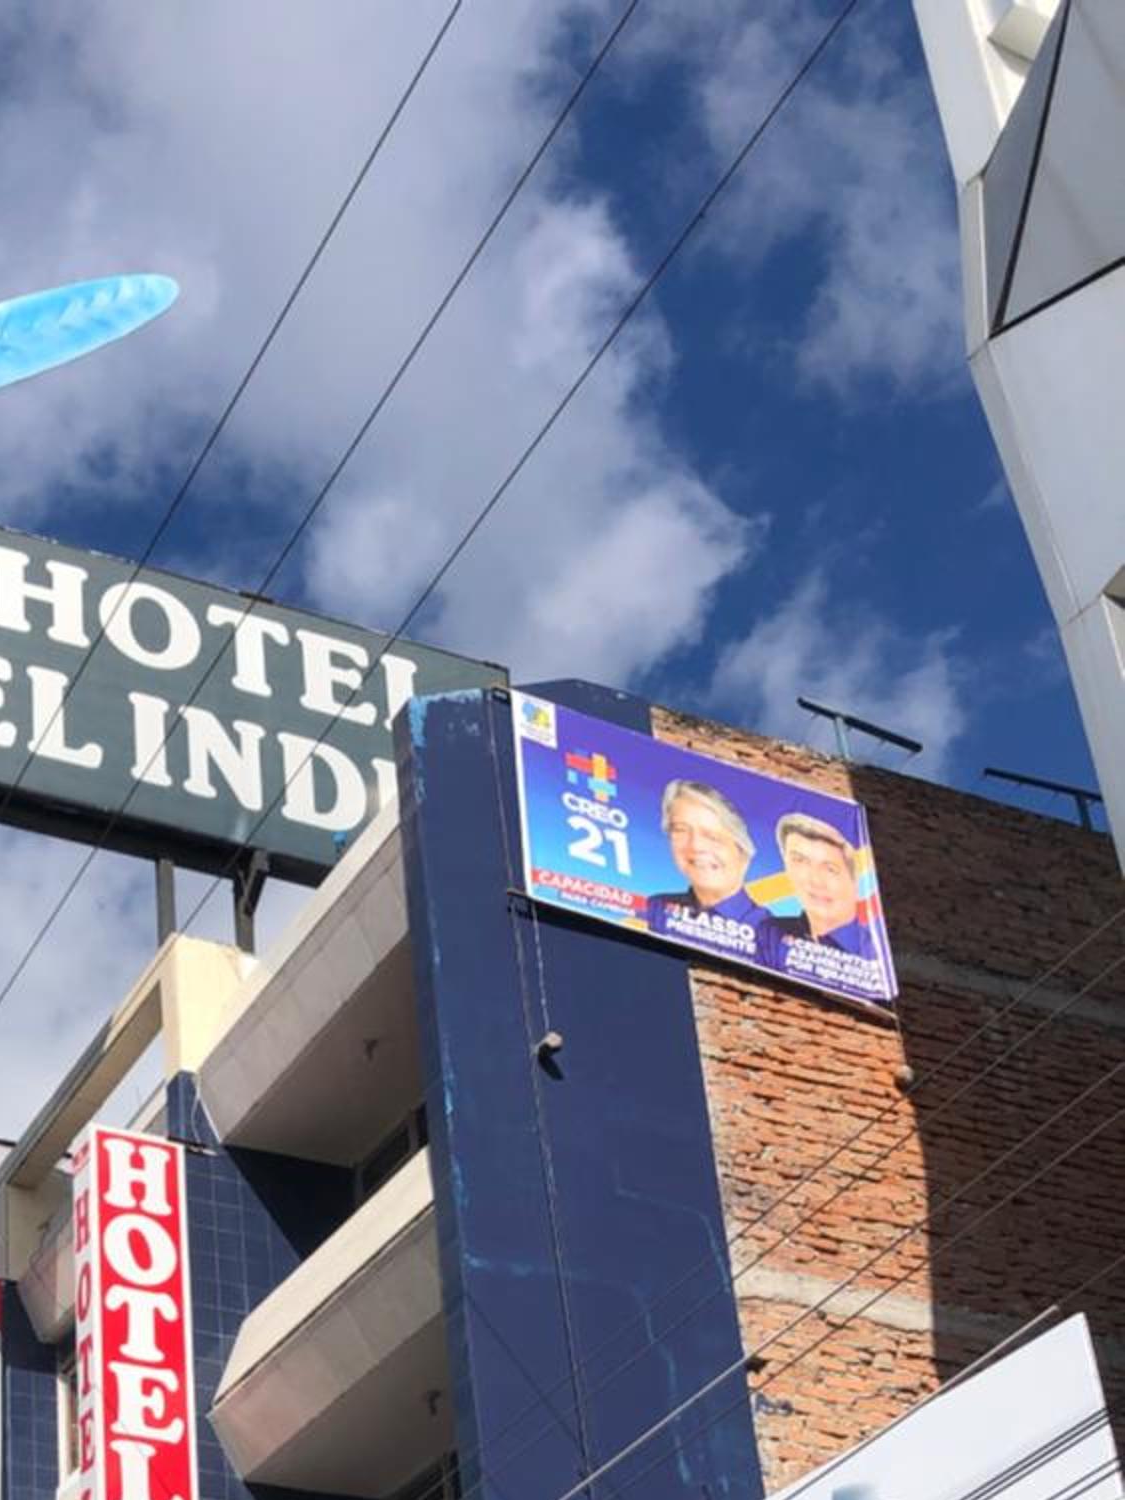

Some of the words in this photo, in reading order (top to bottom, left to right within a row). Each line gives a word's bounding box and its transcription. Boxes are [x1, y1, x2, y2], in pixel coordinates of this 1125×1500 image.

[562, 792, 628, 829] CREO
[567, 816, 632, 877] 21
[682, 908, 756, 942] LASSO
